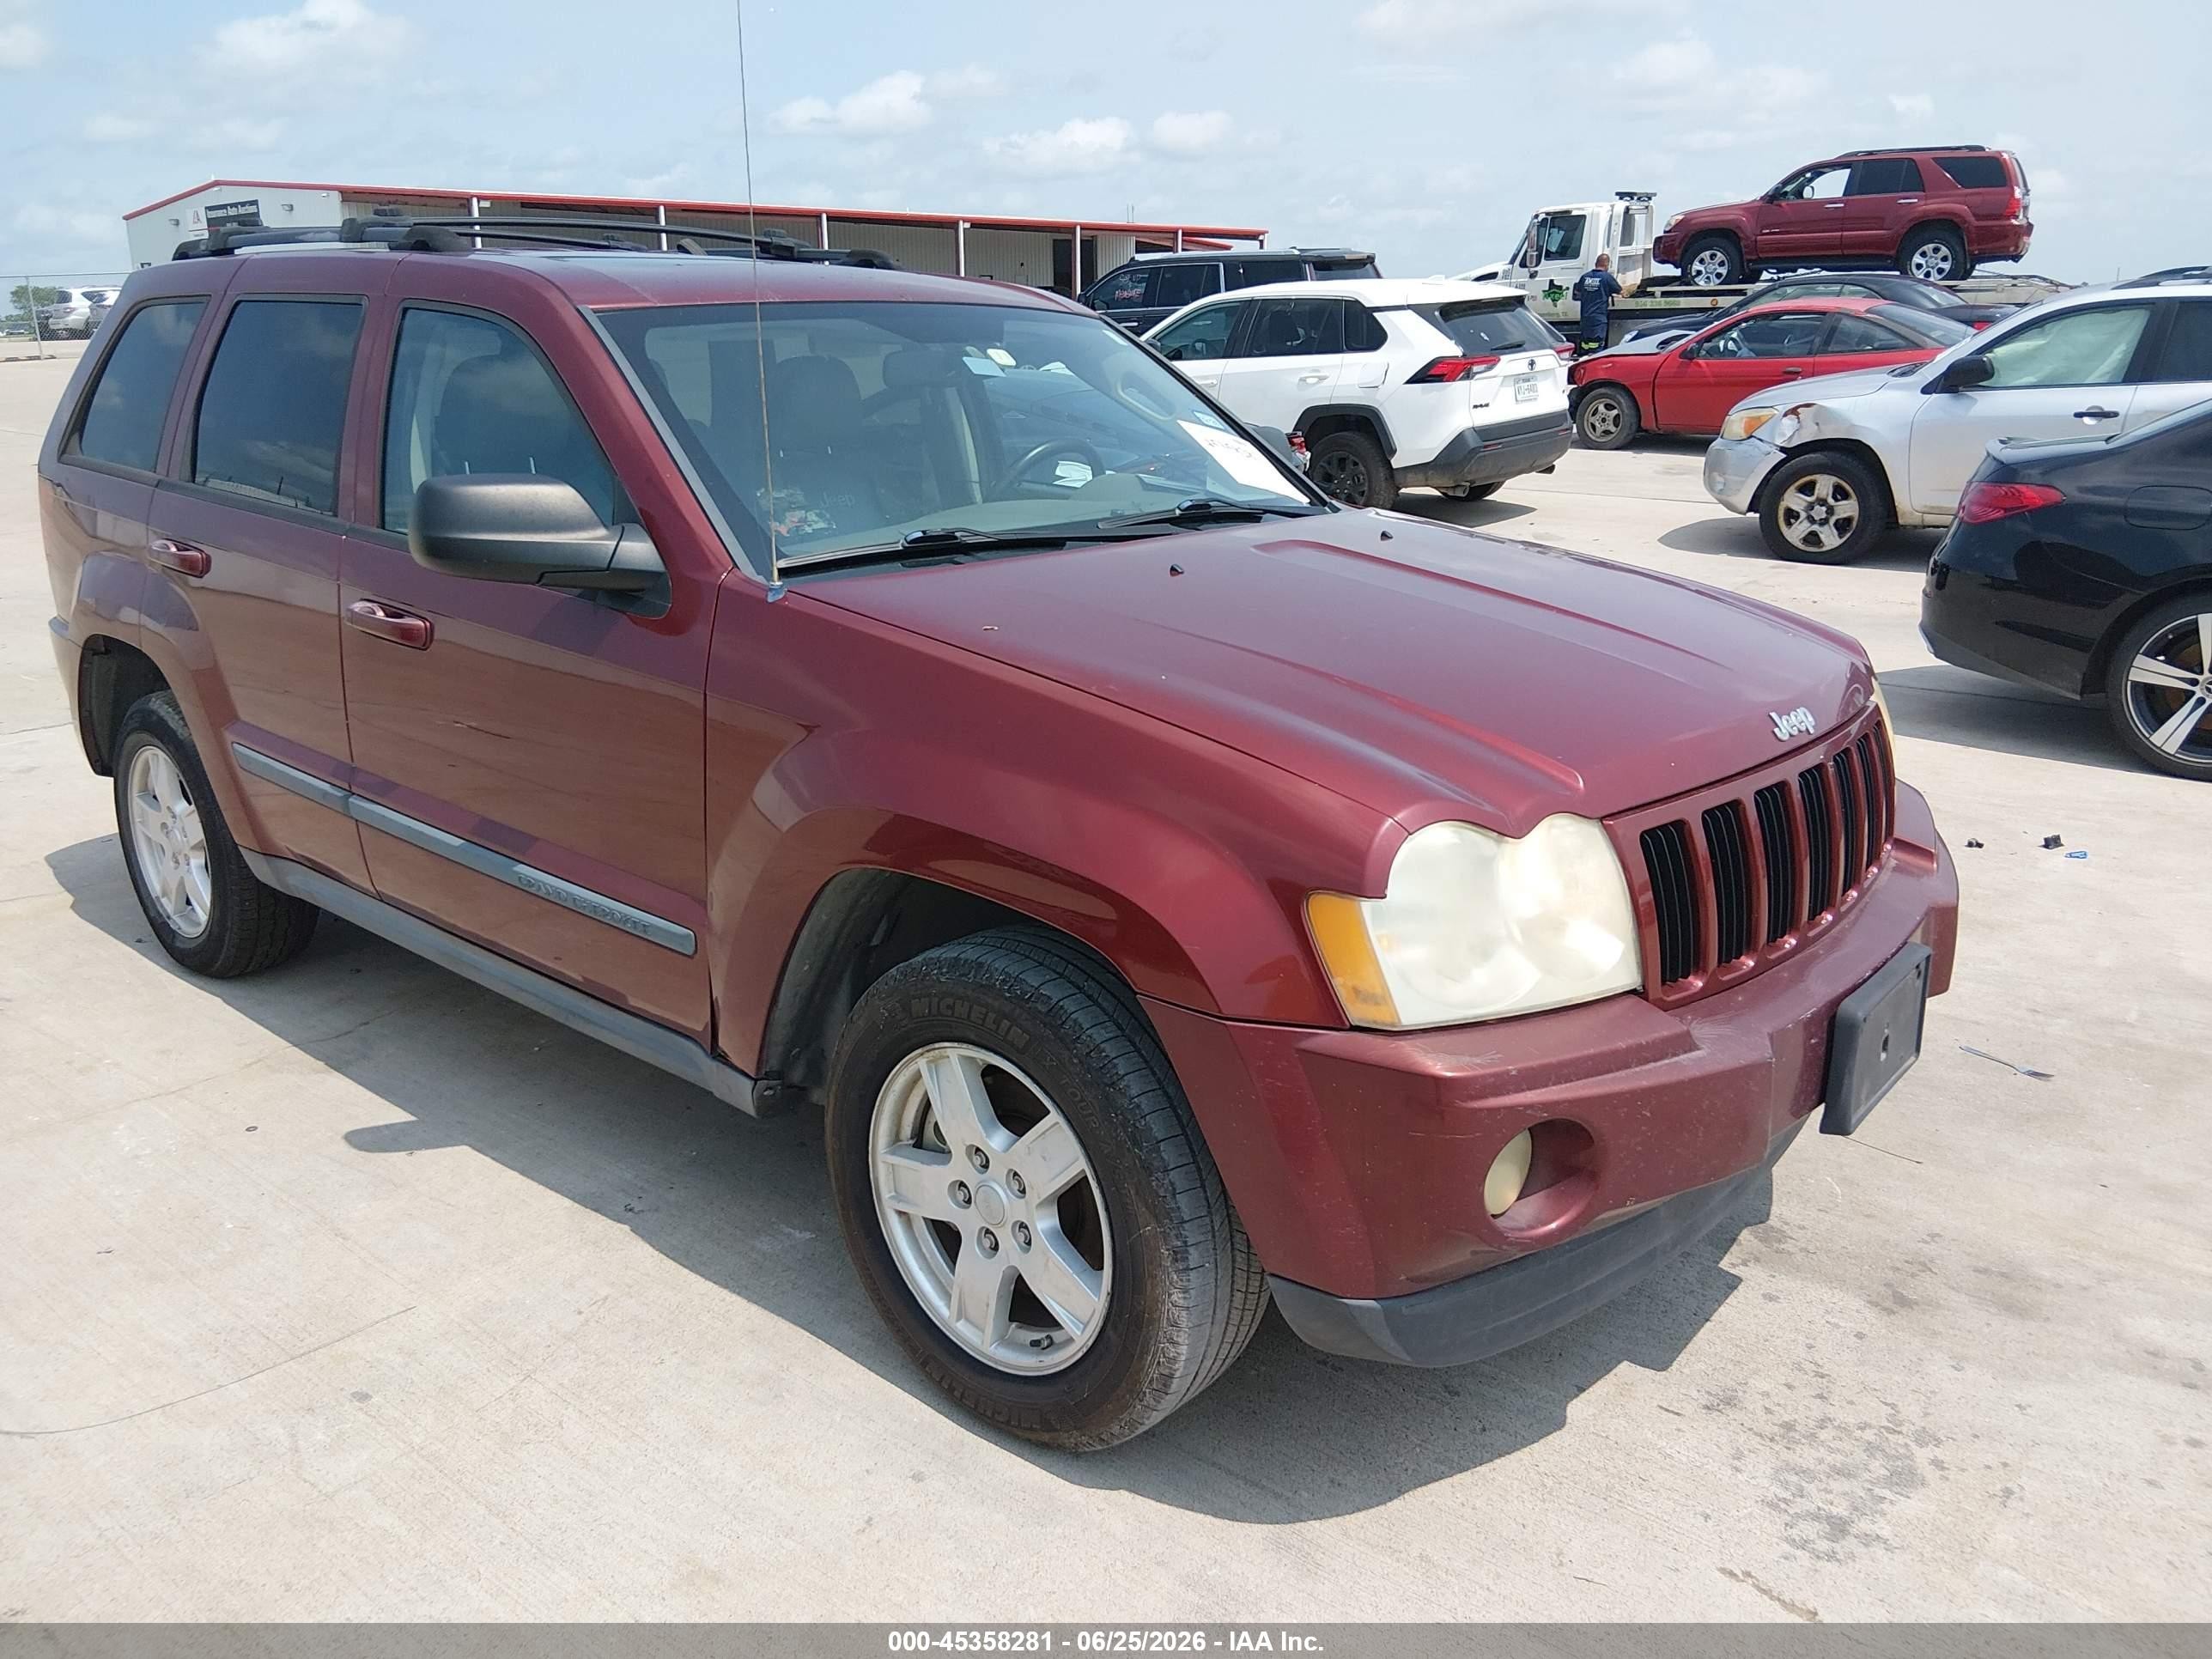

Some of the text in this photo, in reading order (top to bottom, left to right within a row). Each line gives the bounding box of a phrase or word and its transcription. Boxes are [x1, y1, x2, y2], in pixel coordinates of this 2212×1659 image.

[1769, 707, 1815, 741] Jeep
[517, 873, 568, 903] GRAND
[910, 997, 1030, 1049] MICHELIN
